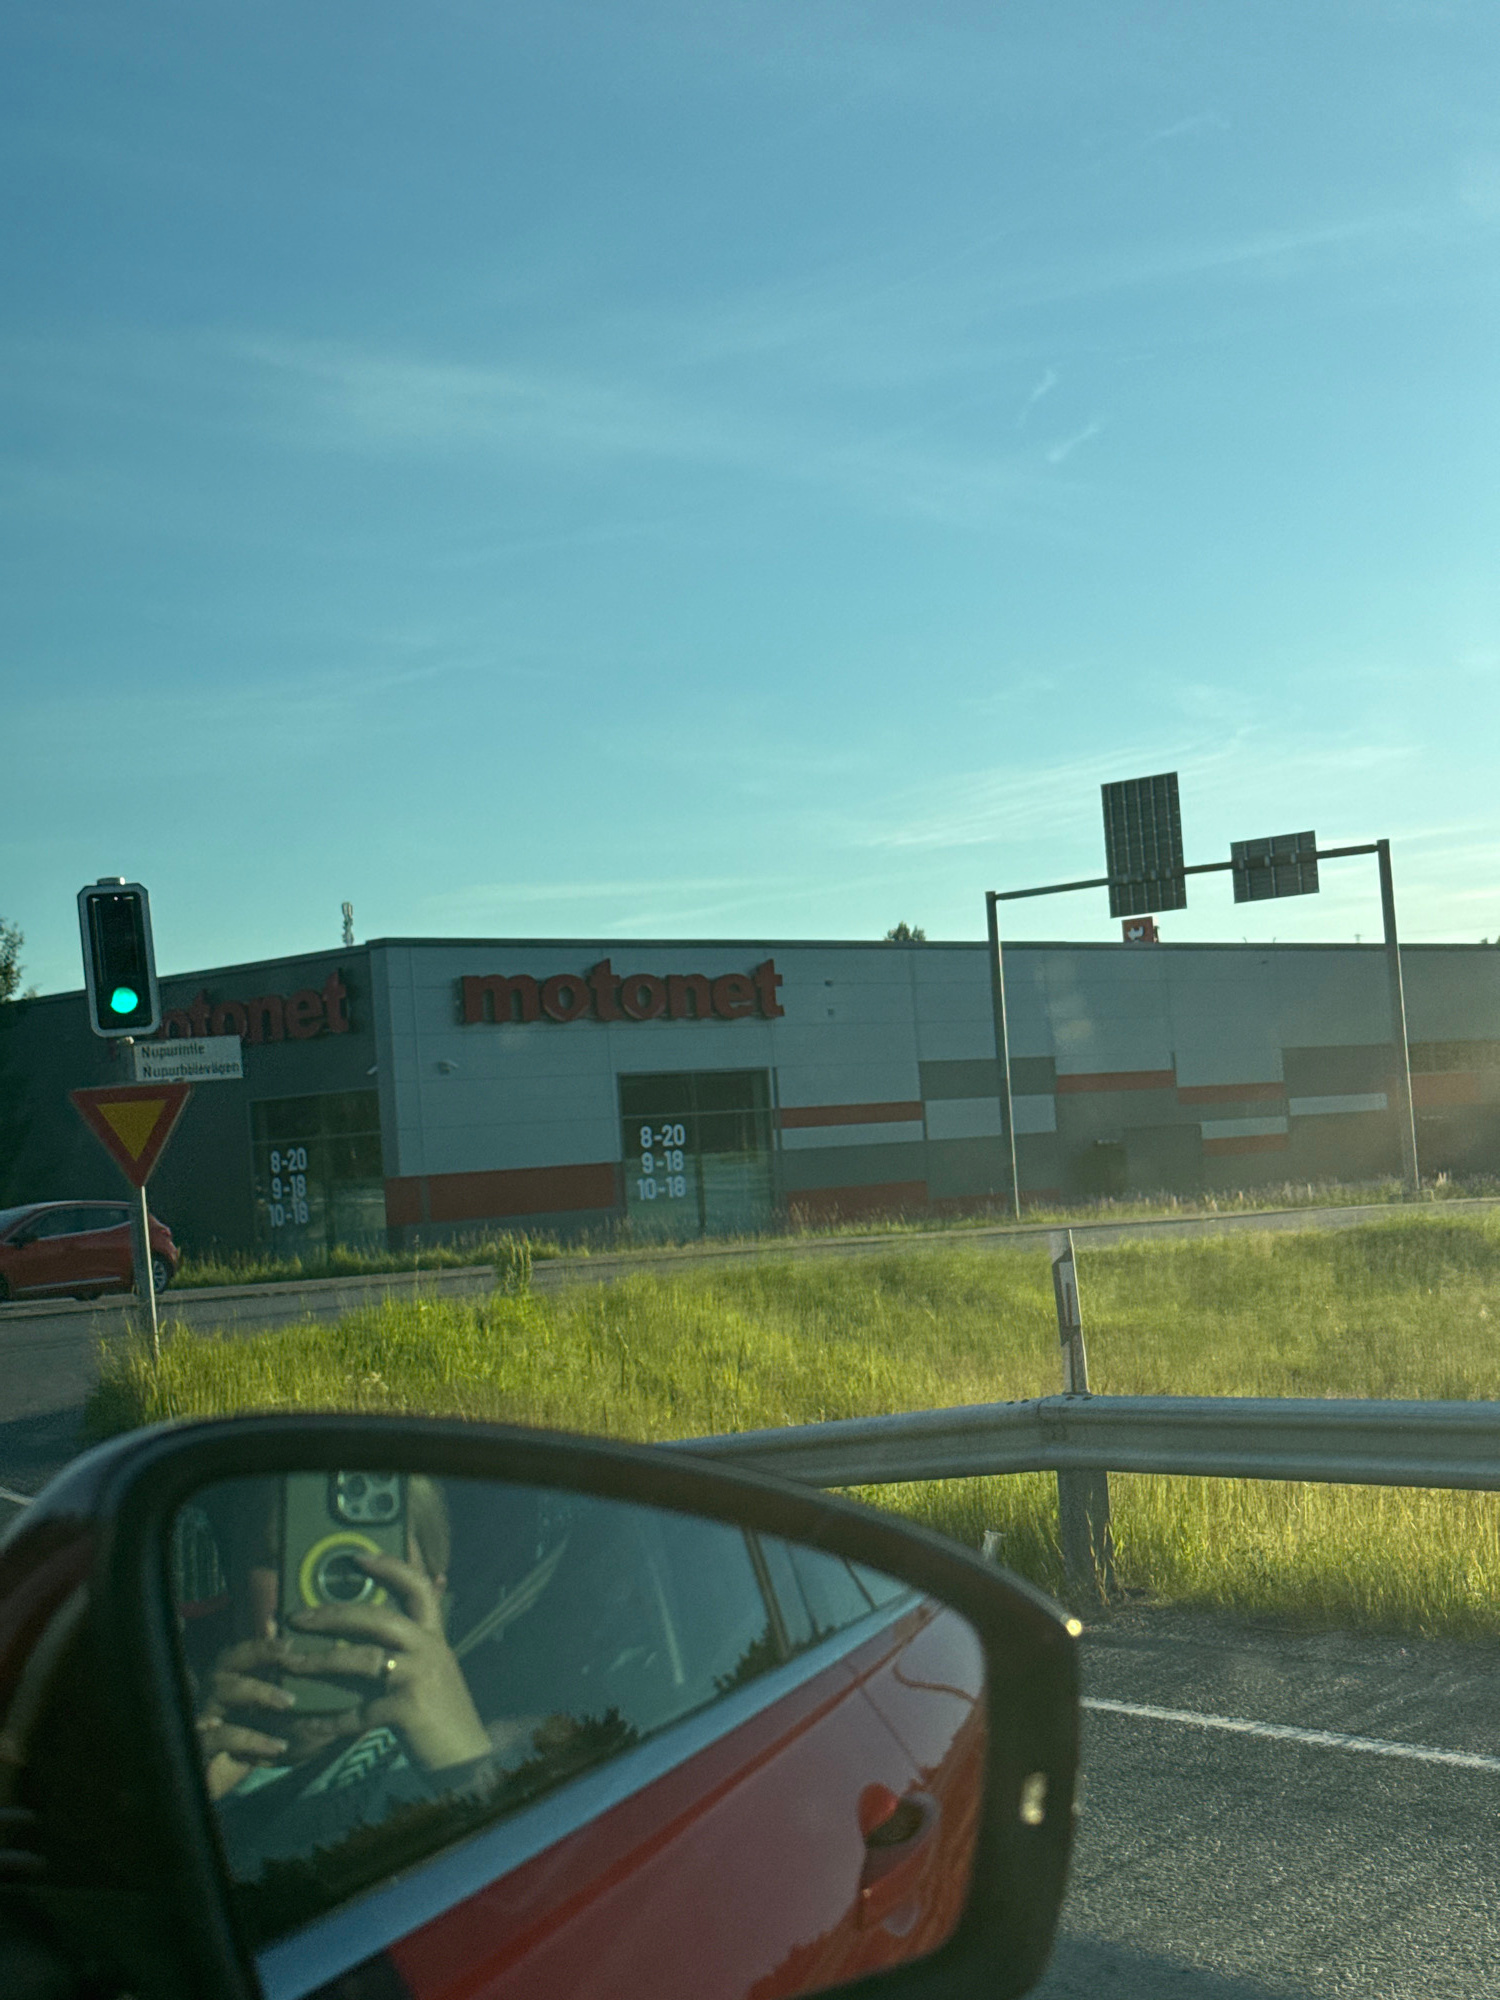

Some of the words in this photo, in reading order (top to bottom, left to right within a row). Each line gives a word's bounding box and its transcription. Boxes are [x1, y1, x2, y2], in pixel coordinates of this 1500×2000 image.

[460, 957, 785, 1023] motonet
[152, 971, 350, 1043] otonet
[640, 1123, 686, 1148] 8-20
[270, 1147, 307, 1173] 8-20
[641, 1149, 684, 1174] 9-18
[272, 1174, 306, 1199] 9-18
[637, 1175, 687, 1200] 10-18
[268, 1201, 309, 1227] 10-18
